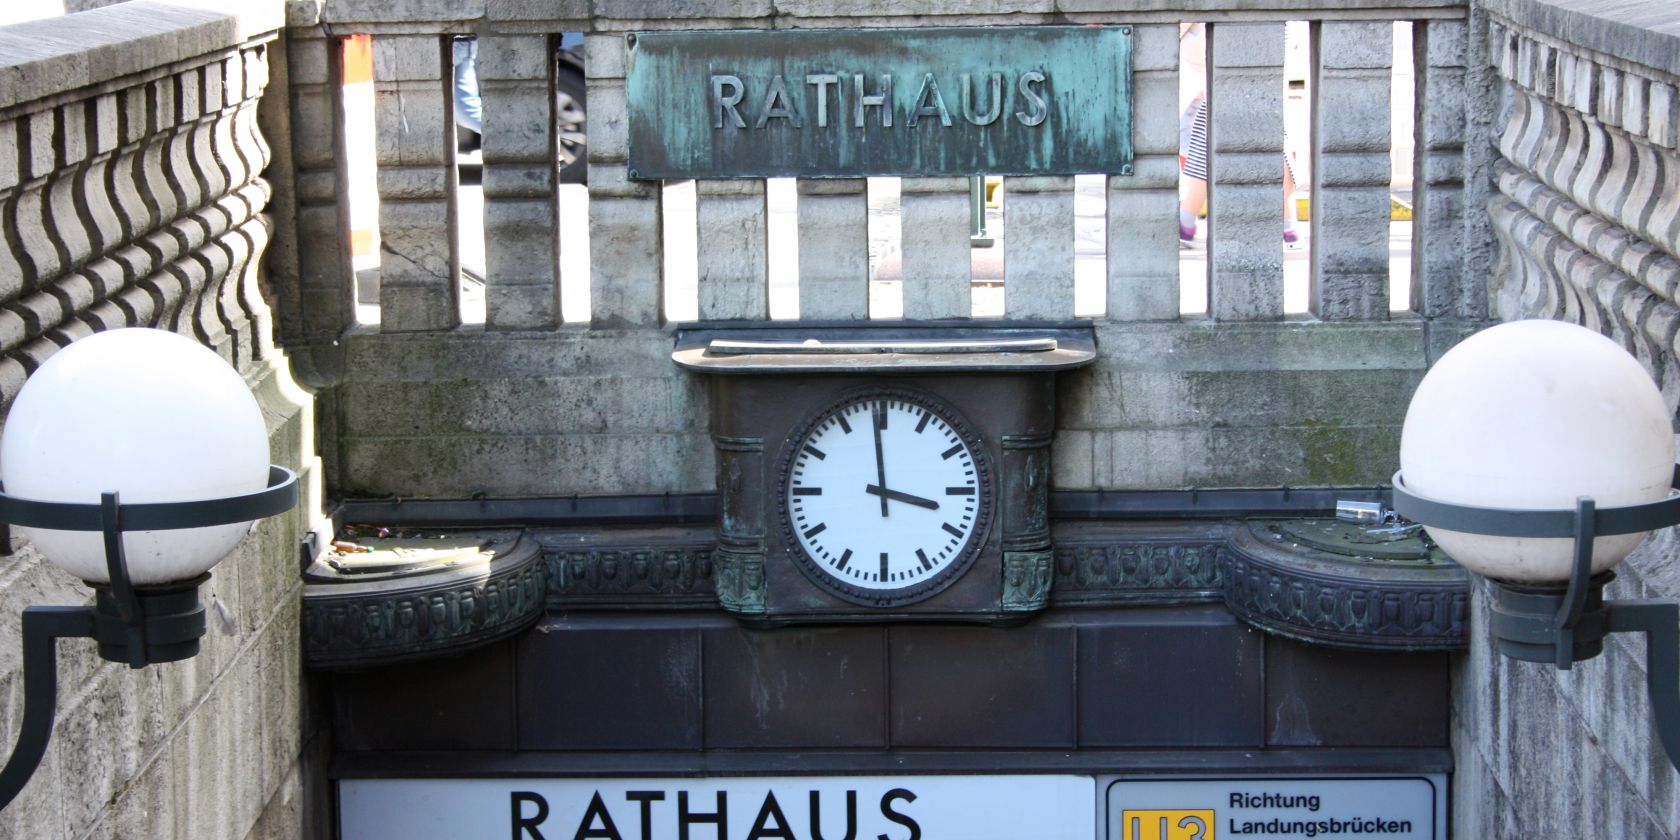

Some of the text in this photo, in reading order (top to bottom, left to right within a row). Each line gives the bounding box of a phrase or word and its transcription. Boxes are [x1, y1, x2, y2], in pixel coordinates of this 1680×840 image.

[712, 71, 1048, 129] RATHAUS
[510, 788, 922, 840] RATHAUS
[1229, 792, 1320, 810] Richtung
[1229, 817, 1412, 836] Landungsbrücken
